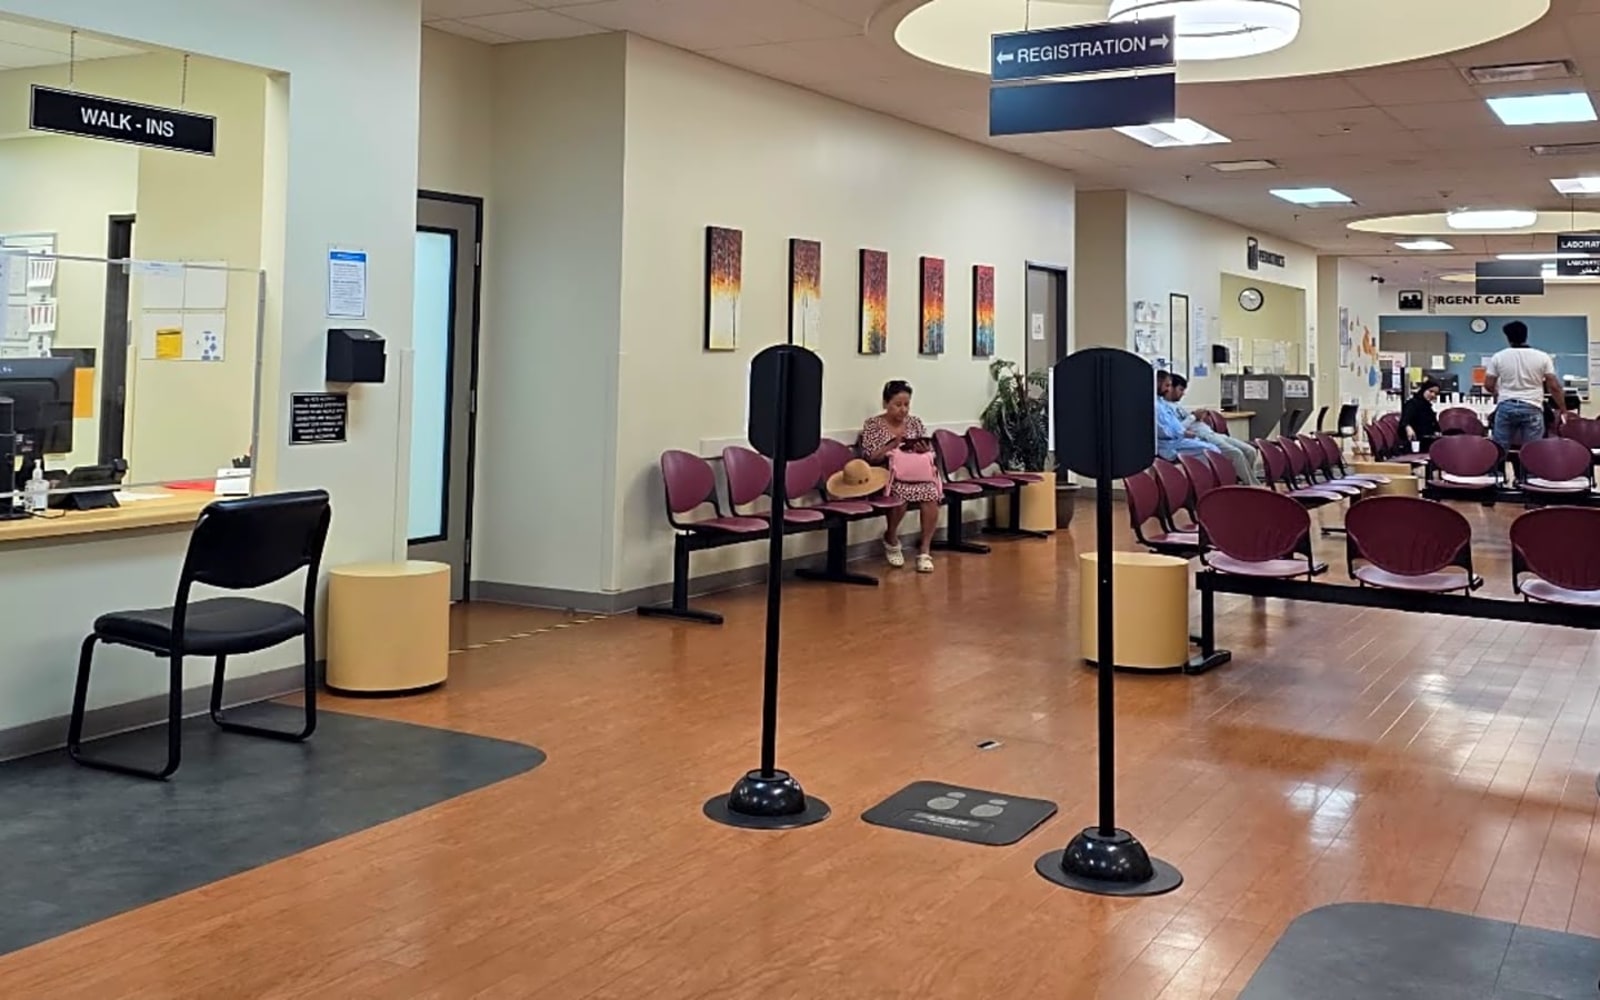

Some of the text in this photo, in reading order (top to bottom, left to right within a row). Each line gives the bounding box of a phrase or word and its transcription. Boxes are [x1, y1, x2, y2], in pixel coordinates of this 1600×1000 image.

[1017, 36, 1146, 63] REGISTRATION
[80, 107, 131, 131] WALK
[145, 117, 174, 138] INS
[1485, 295, 1521, 305] CARE
